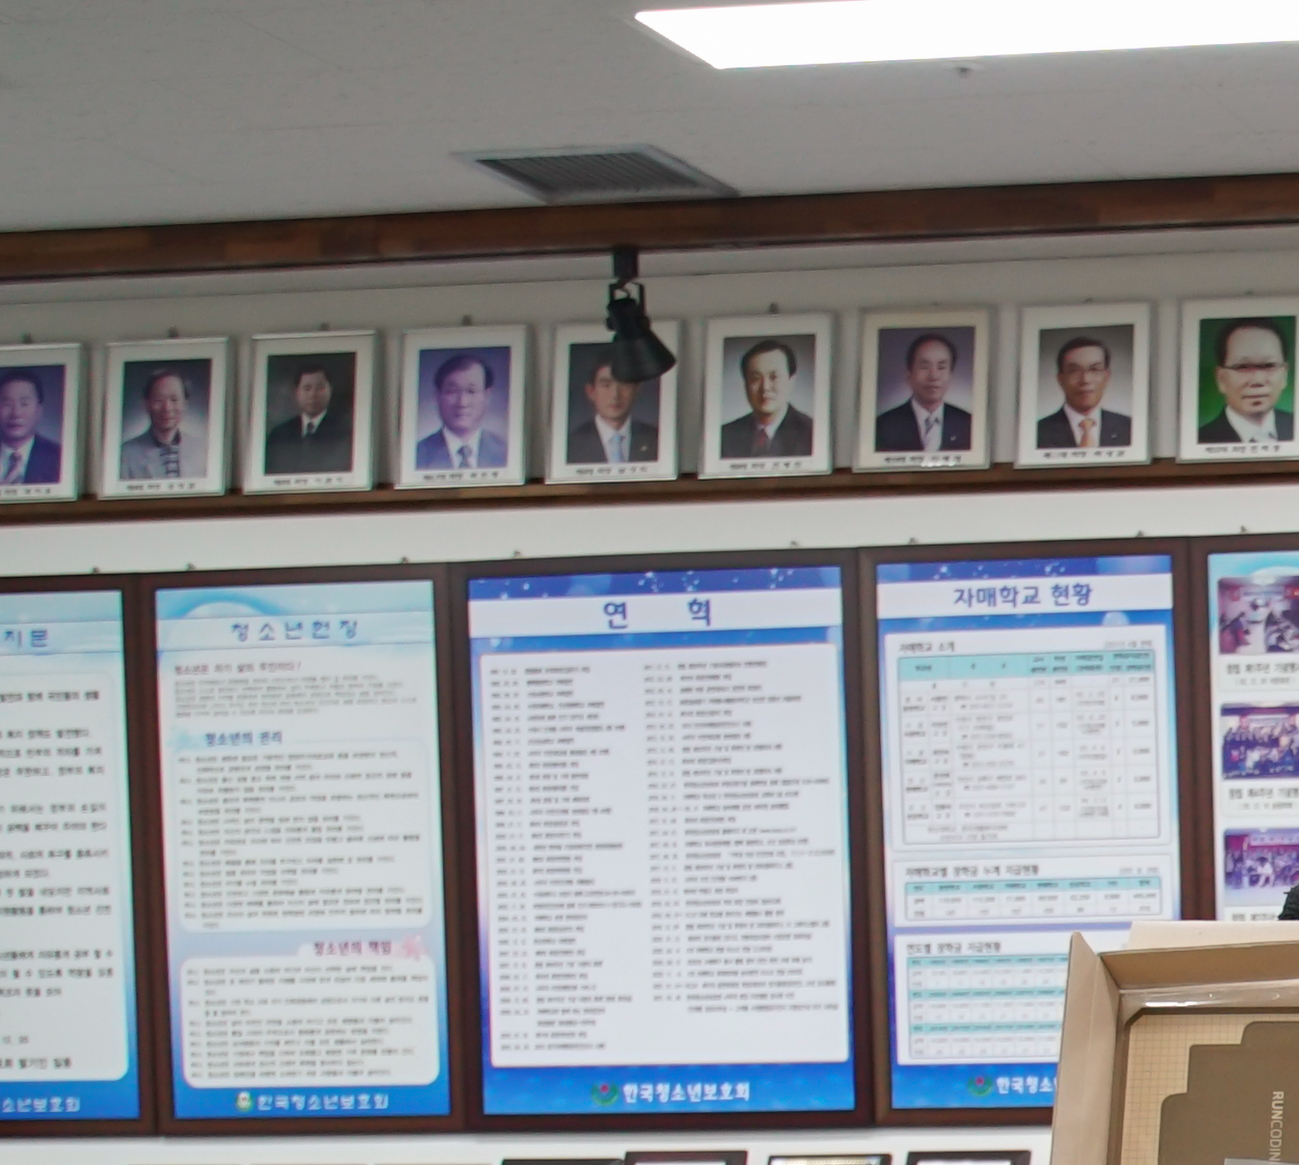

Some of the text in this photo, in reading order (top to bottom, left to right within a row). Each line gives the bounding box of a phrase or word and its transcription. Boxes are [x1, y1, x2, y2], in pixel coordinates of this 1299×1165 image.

[953, 583, 1093, 609] 자매학교 현황
[623, 1082, 750, 1103] 한국청소년보호회
[996, 1076, 1057, 1095] 한국청소
